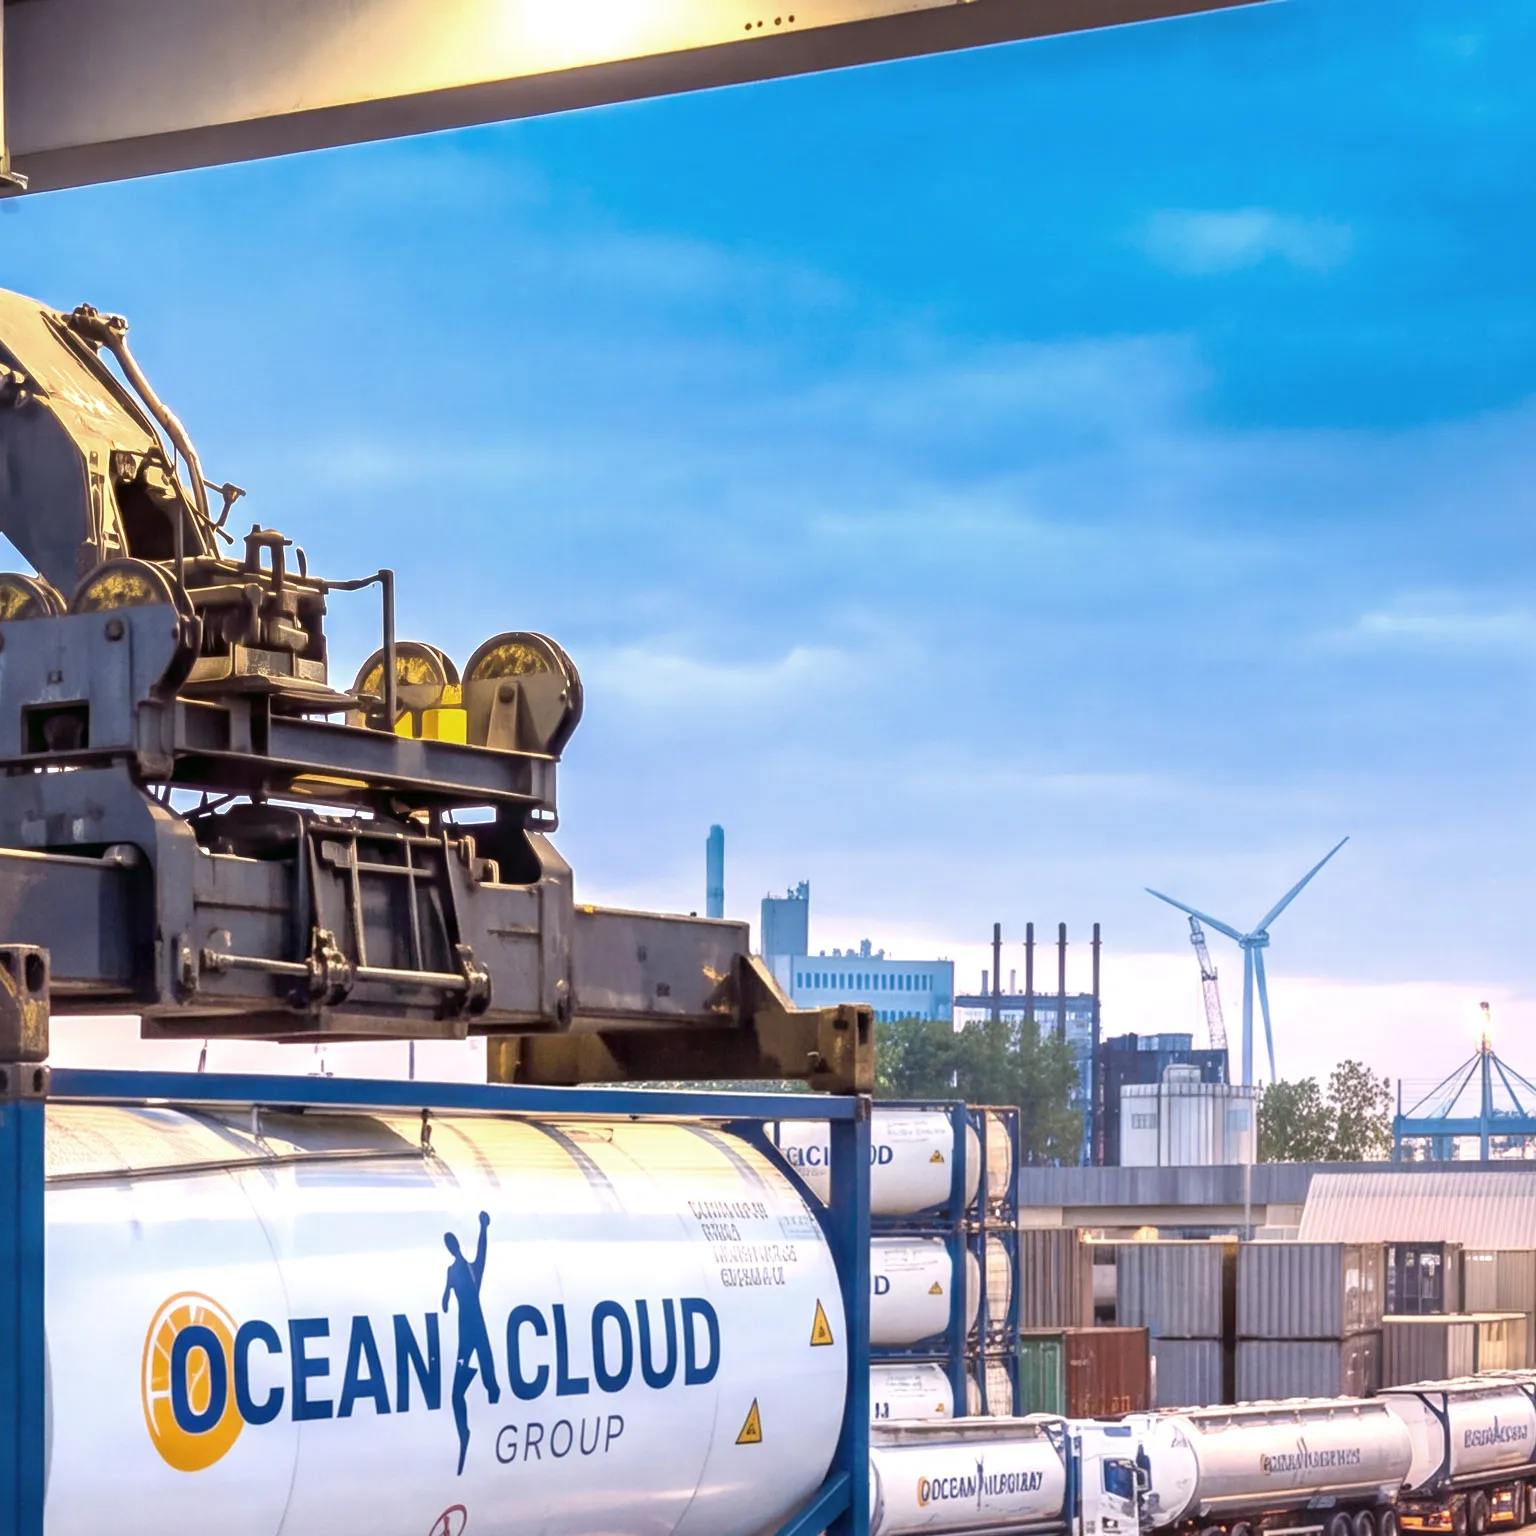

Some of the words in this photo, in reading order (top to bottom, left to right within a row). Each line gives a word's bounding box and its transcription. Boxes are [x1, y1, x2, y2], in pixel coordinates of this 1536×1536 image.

[171, 1312, 442, 1434] OCEAN
[506, 1297, 721, 1401] CLOUD
[495, 1414, 624, 1464] GROUP
